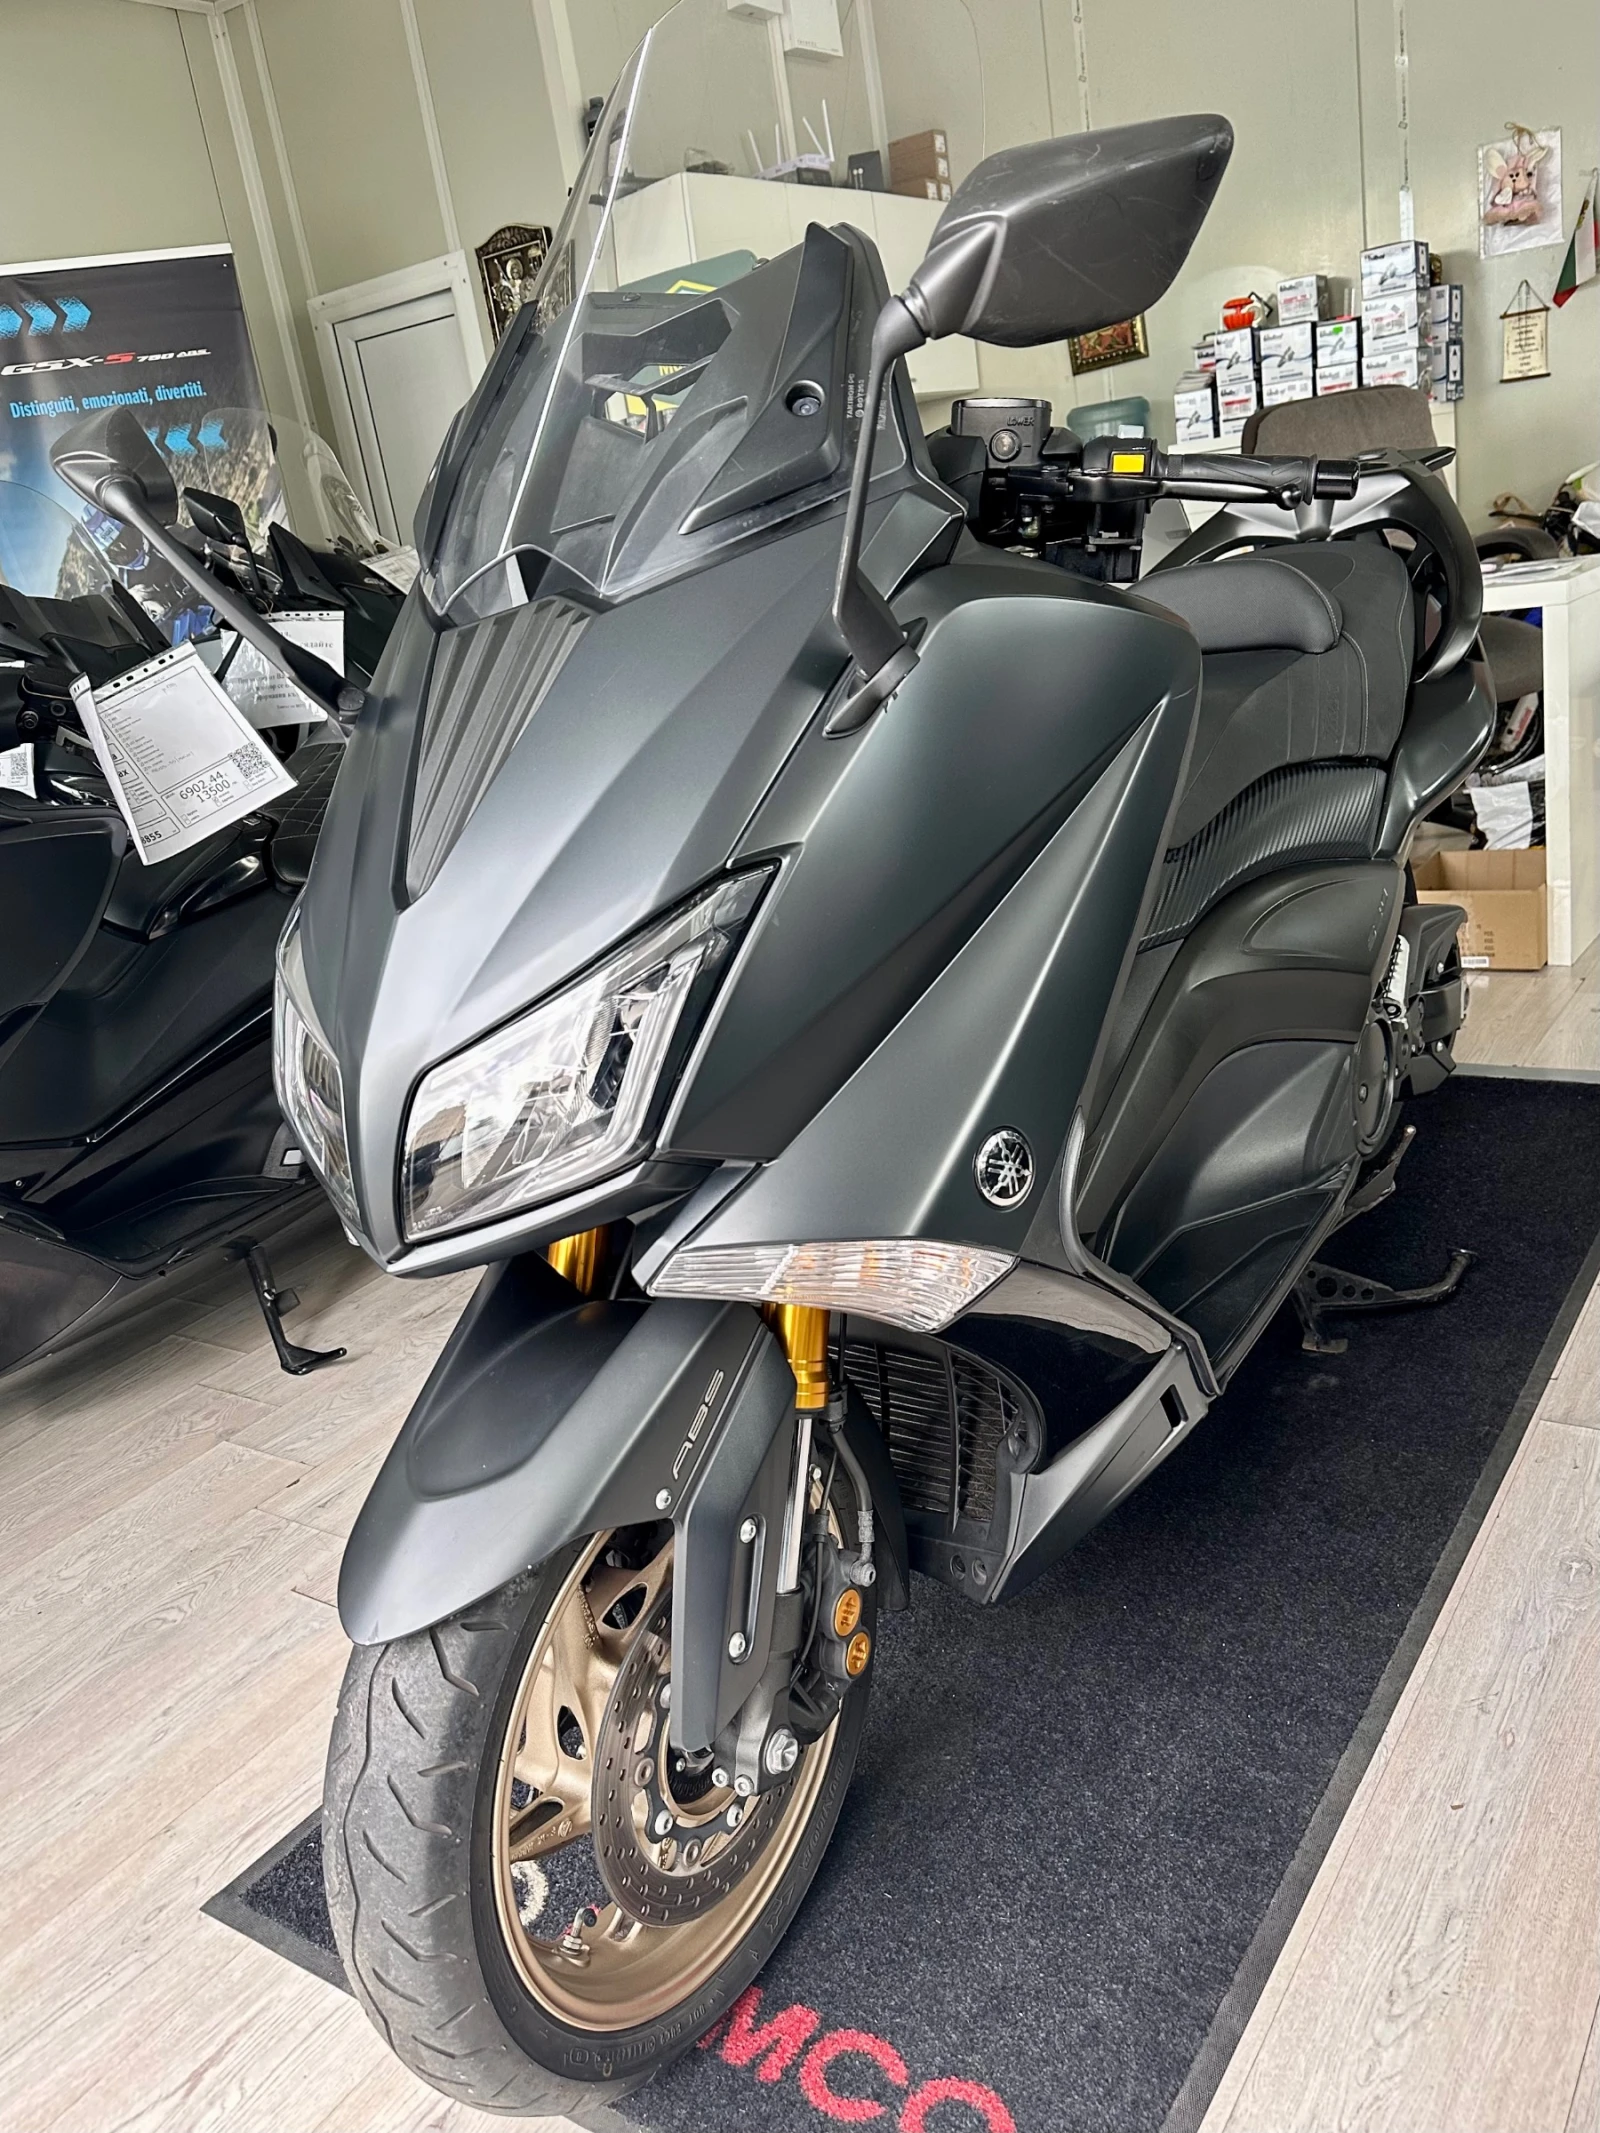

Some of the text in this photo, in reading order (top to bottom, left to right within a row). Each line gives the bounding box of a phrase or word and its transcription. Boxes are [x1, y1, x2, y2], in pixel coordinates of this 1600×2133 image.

[1, 352, 136, 376] GSX-S
[9, 380, 207, 419] Distinguiti, emozionati, divertiti.
[1006, 415, 1035, 427] LOWER
[179, 771, 224, 800] 6902.44
[196, 779, 231, 804] 13500
[671, 1369, 725, 1480] ABS
